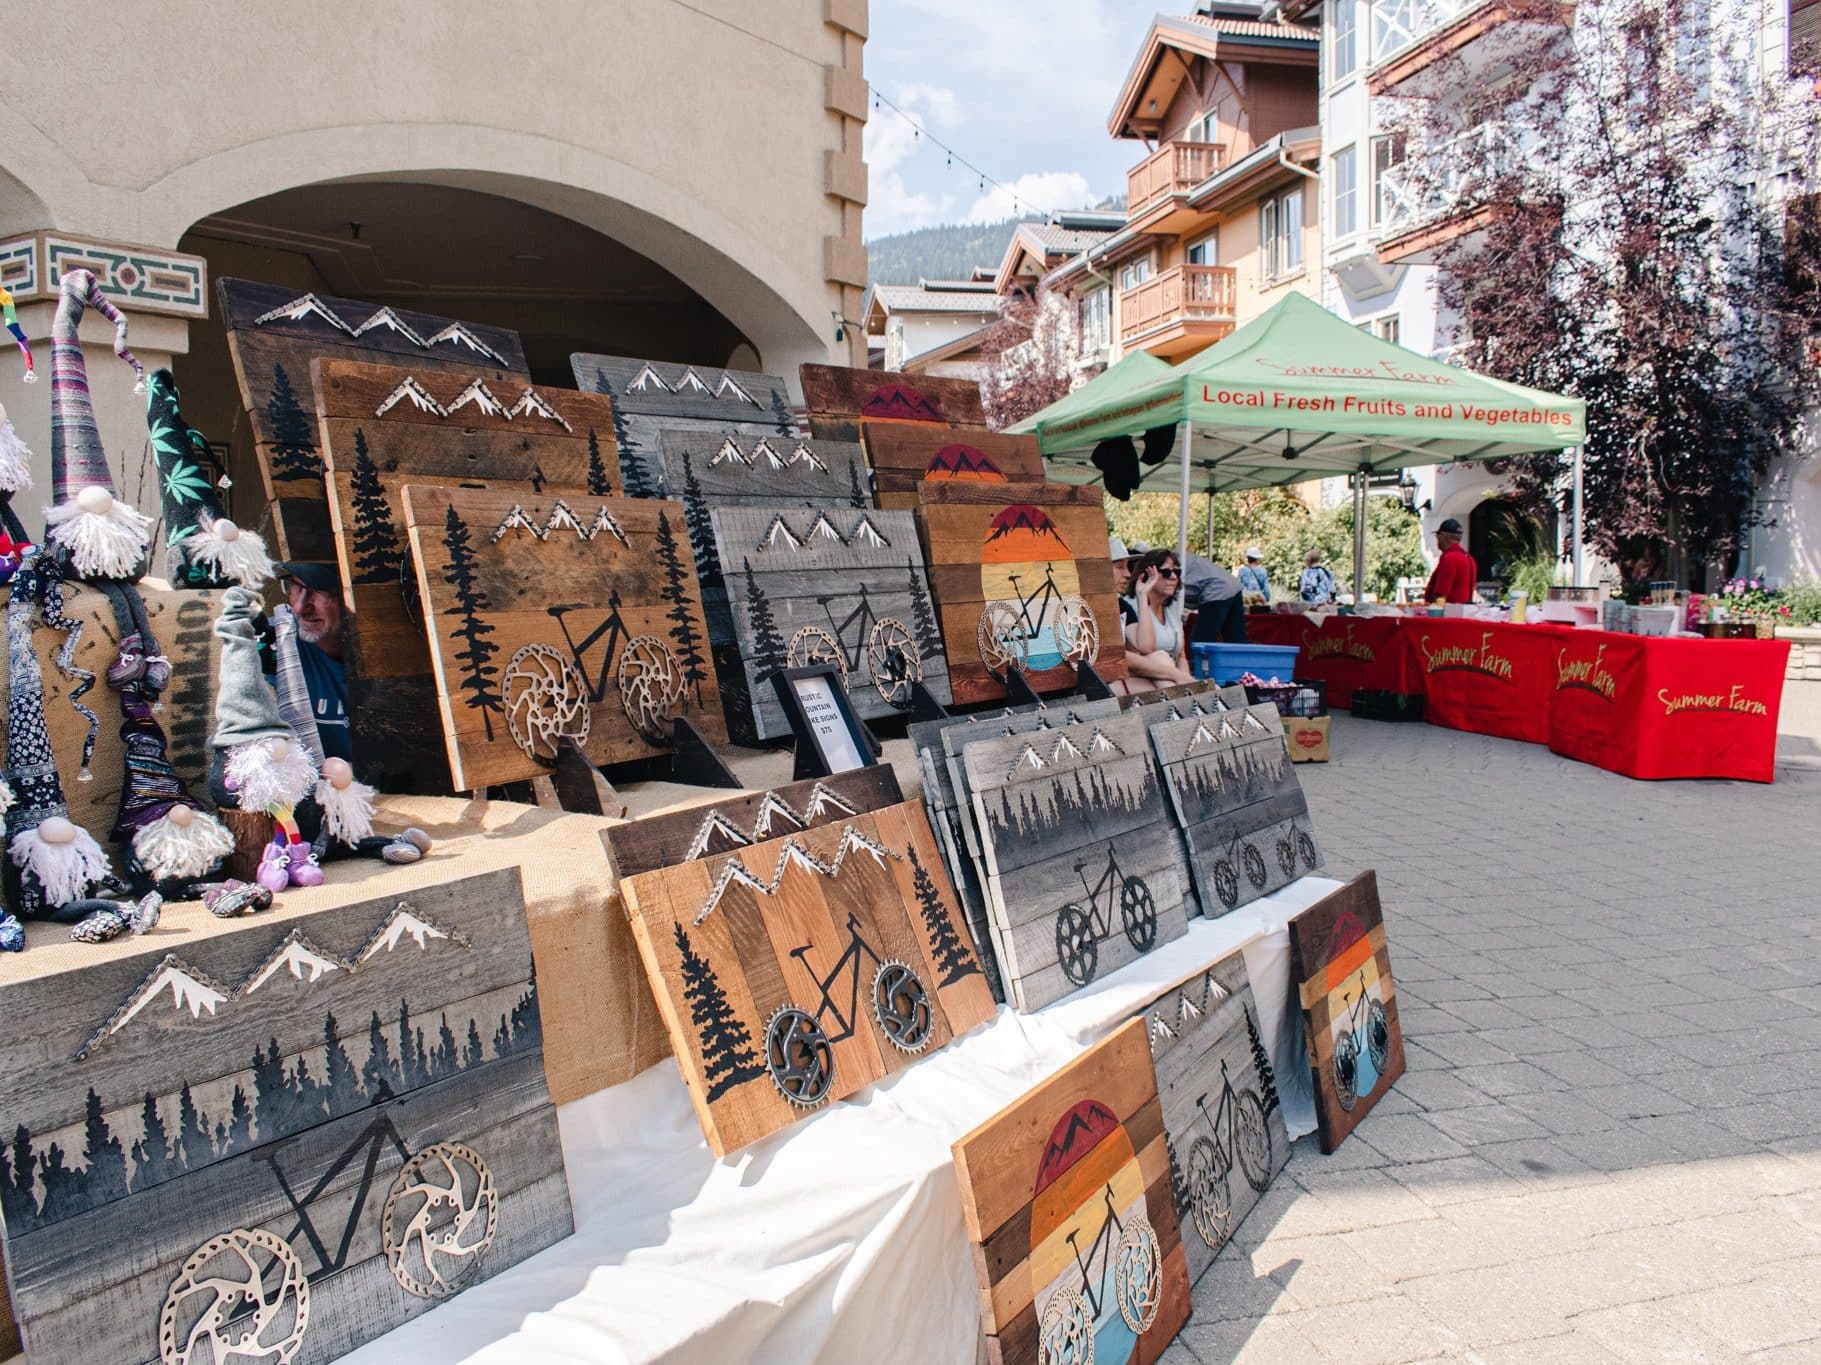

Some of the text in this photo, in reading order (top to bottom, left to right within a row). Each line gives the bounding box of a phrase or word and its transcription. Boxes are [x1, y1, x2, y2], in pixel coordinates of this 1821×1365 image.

[1378, 359, 1456, 384] Farm
[1202, 385, 1573, 426] Local Fresh Fruits and Vegetables
[1347, 622, 1376, 663] Farm
[1421, 632, 1513, 679] Summer Farm
[1591, 643, 1616, 698] Farm
[805, 703, 831, 713] OUNTAIN
[1657, 684, 1768, 716] Summer Farm
